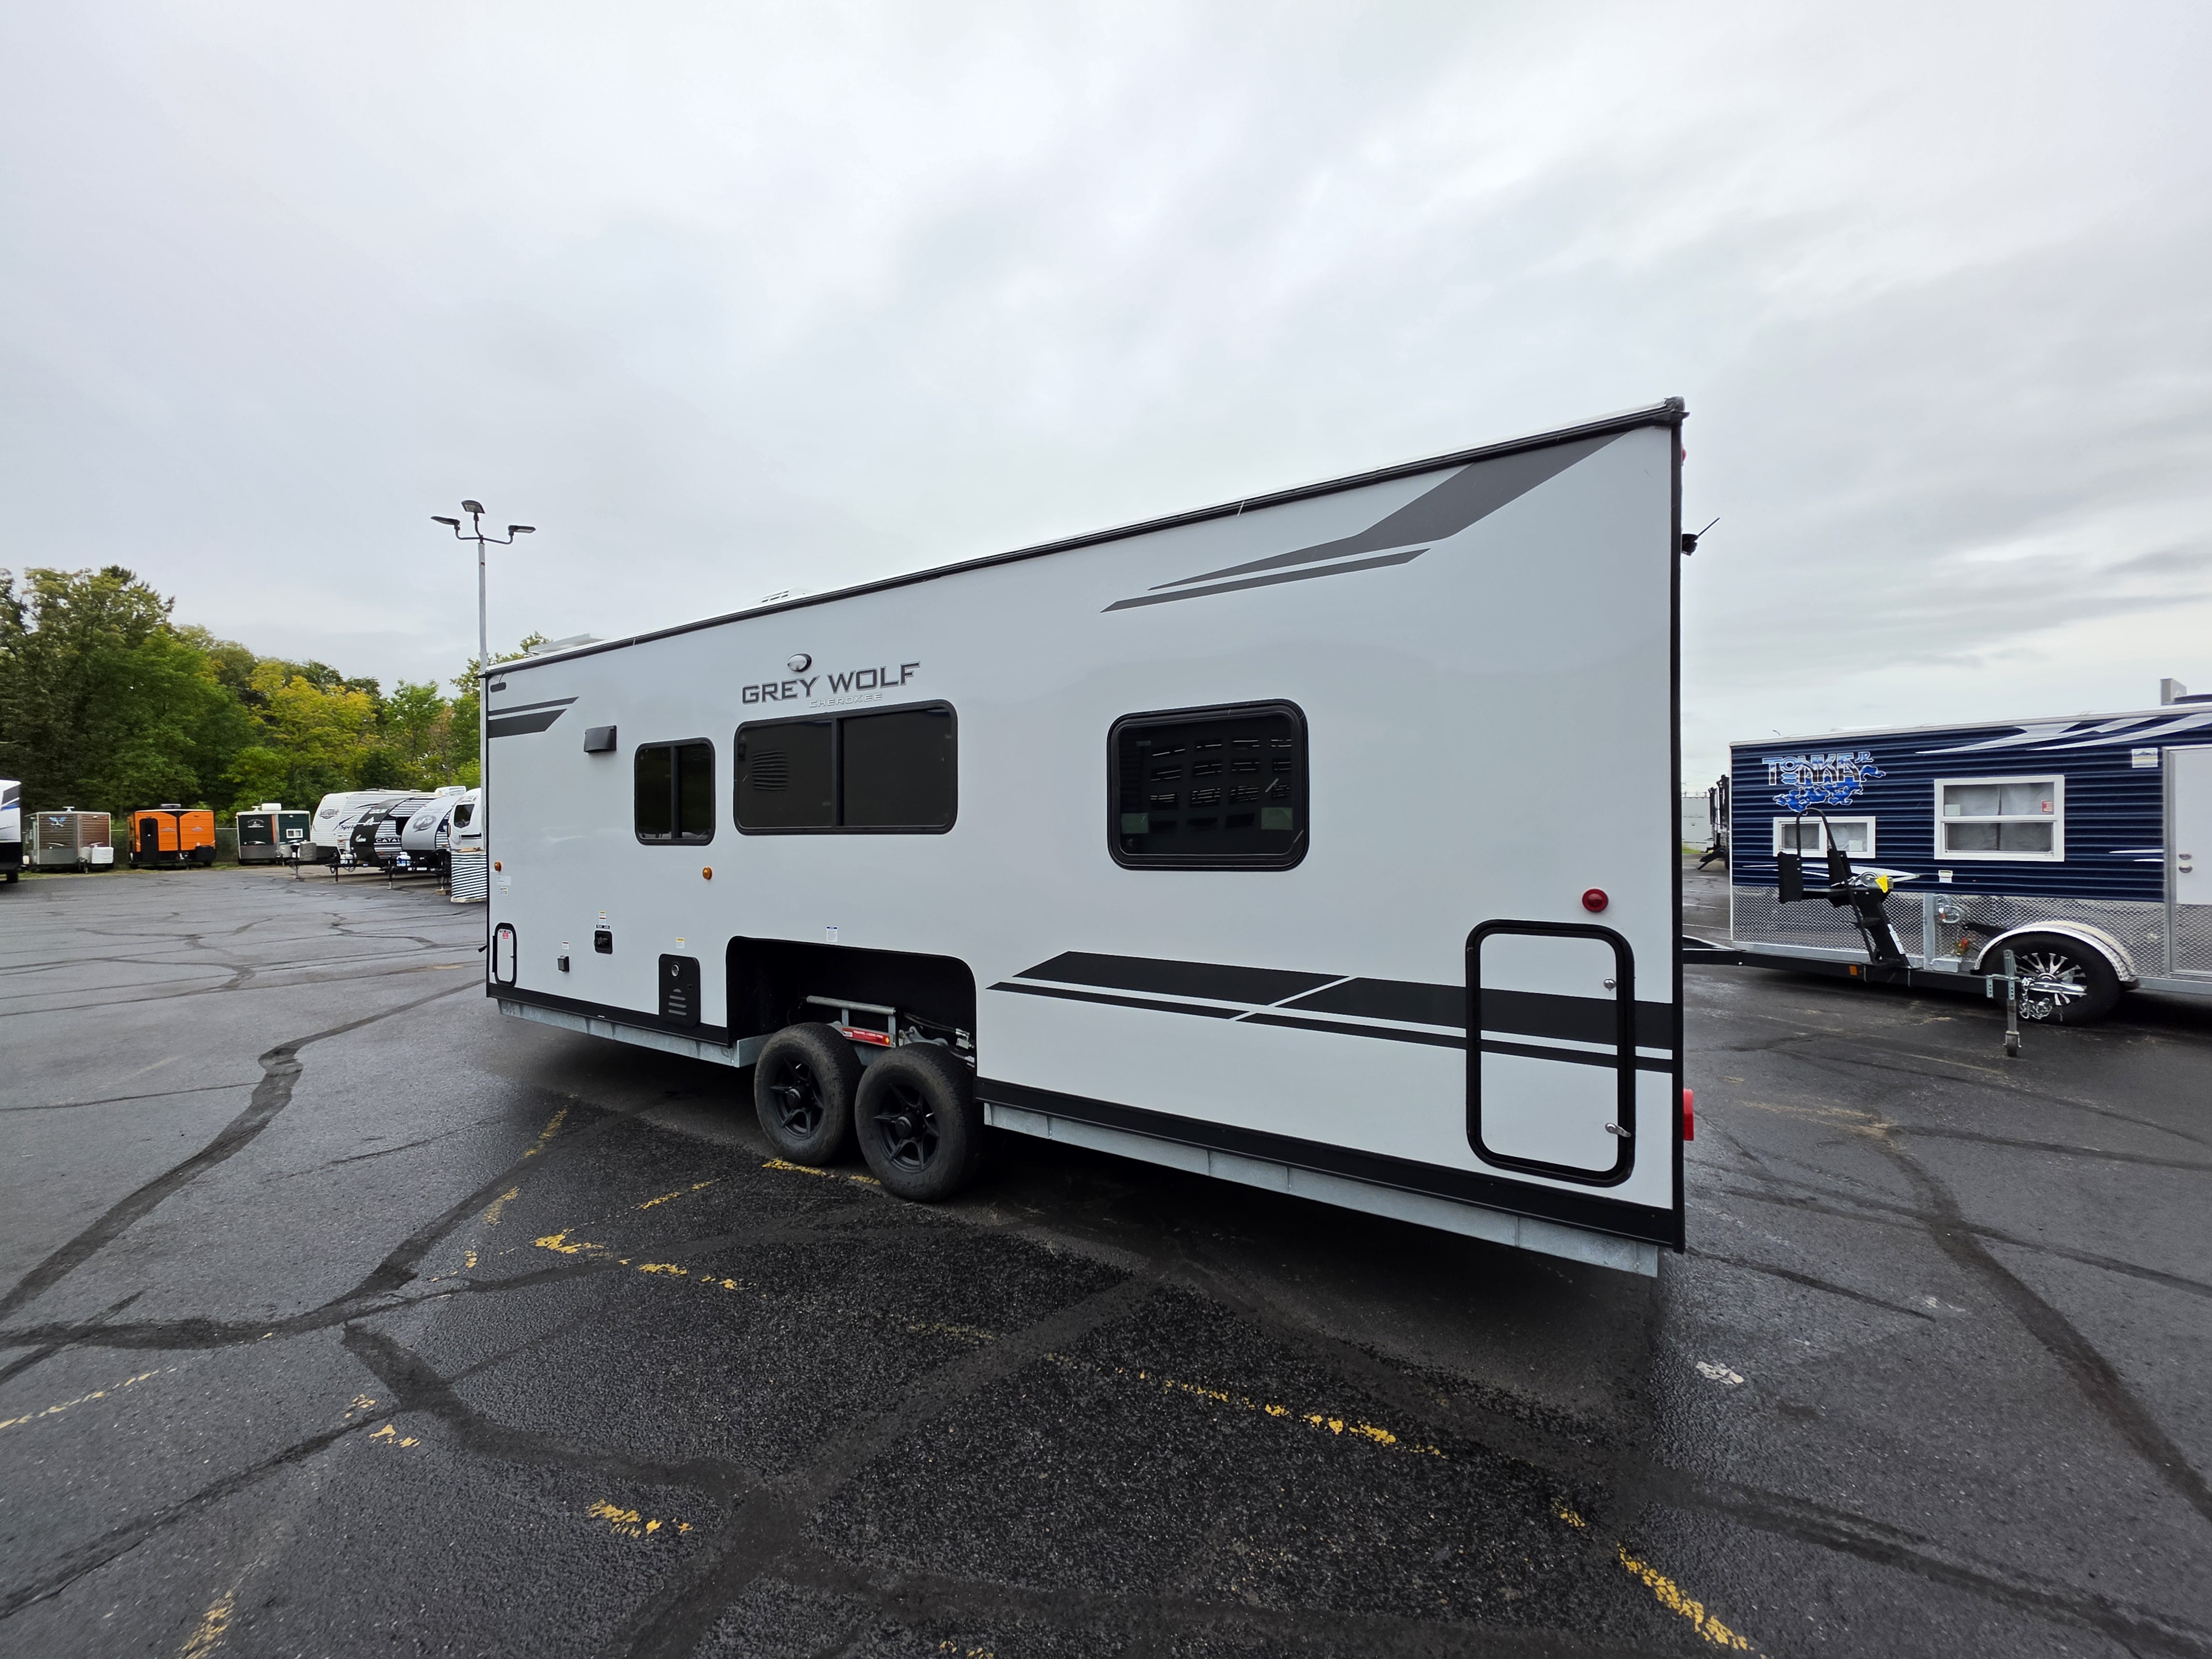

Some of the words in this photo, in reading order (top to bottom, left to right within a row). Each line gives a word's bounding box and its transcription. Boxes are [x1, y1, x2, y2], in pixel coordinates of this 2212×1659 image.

[742, 676, 820, 705] GREY
[827, 661, 920, 694] WOLF
[809, 693, 883, 708] CHEROKEE
[1762, 753, 1861, 786] TONKA
